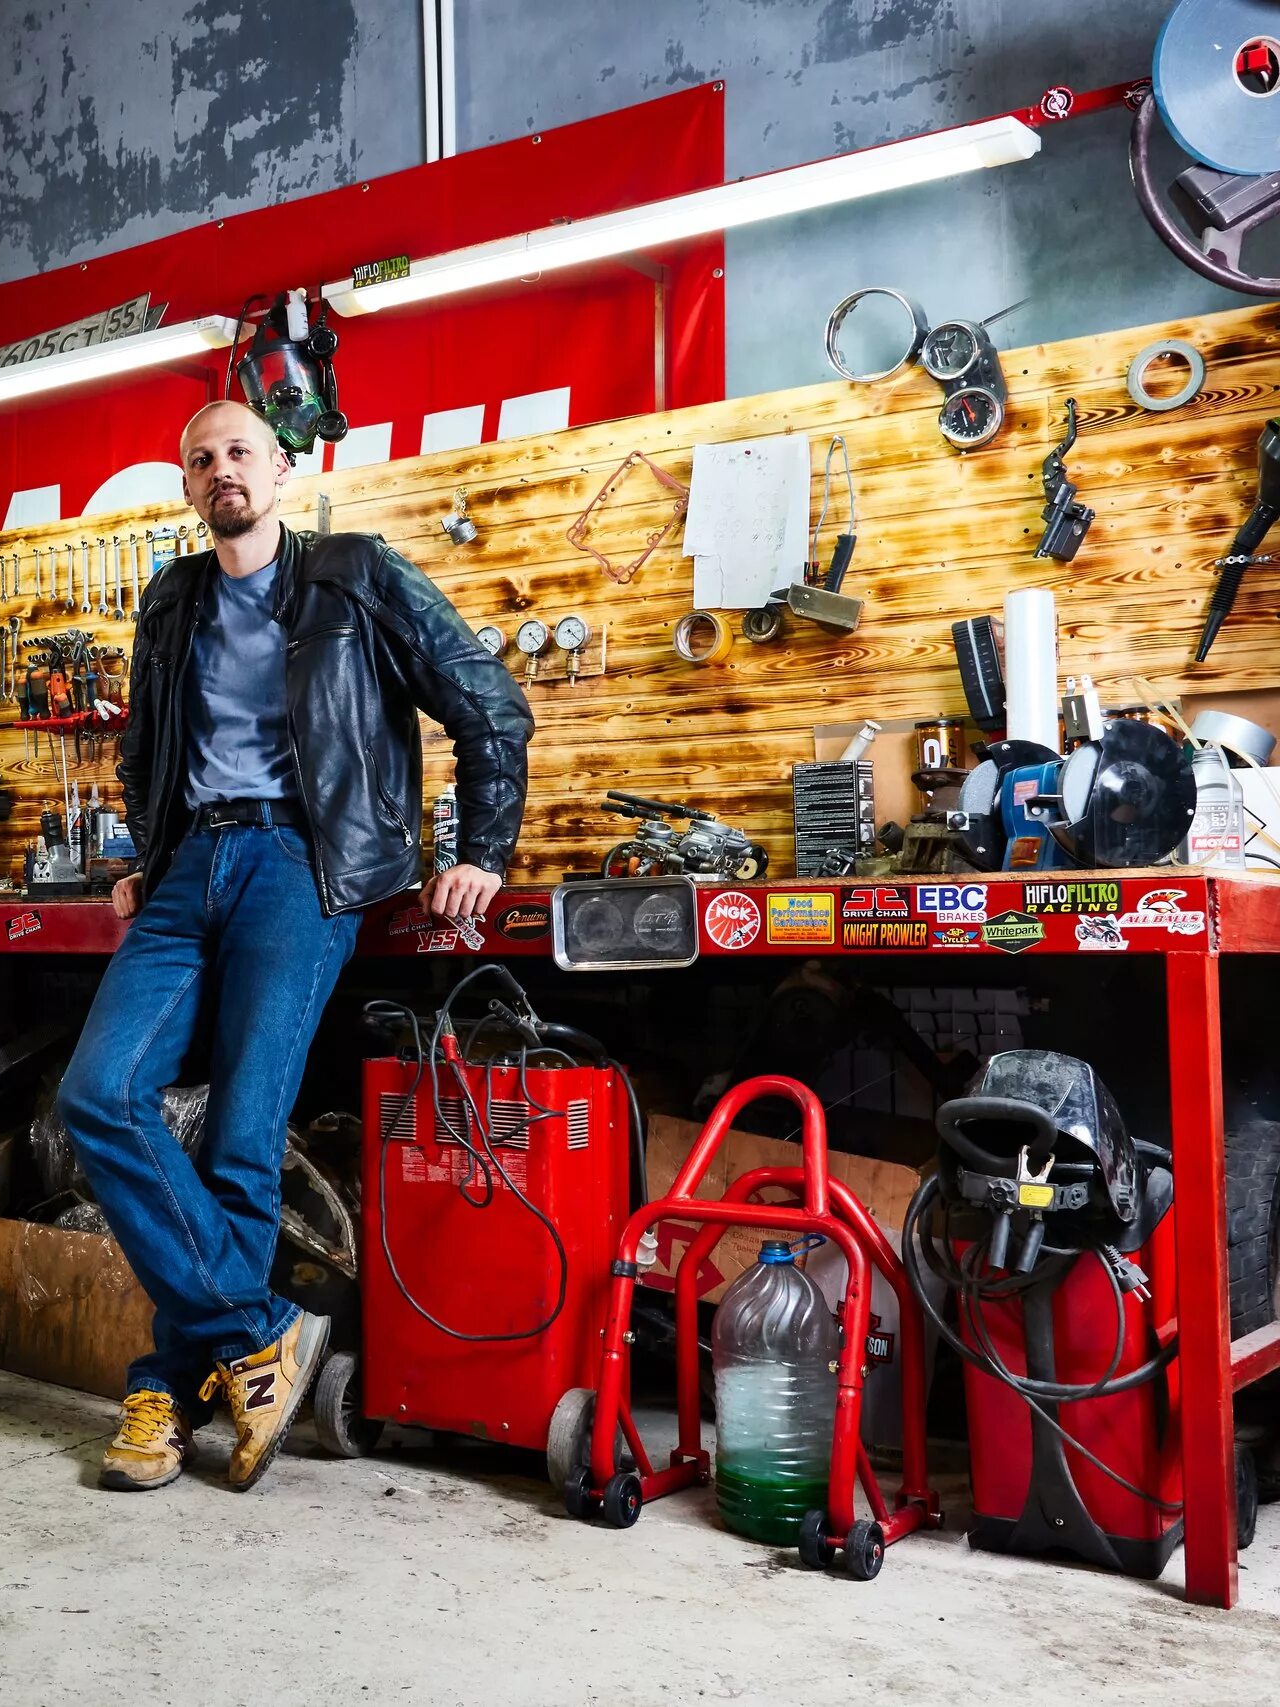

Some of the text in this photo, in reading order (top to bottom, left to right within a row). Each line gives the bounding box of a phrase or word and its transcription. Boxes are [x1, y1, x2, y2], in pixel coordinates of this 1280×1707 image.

[354, 256, 408, 280] HIFLOFILTRO
[355, 270, 408, 287] RACING
[108, 301, 137, 333] 55
[919, 886, 984, 911] EBC
[1026, 883, 1118, 904] HIFLOFILTRO
[715, 905, 751, 921] NGK
[771, 908, 829, 918] Performance
[843, 910, 874, 918] DRIVE
[1027, 903, 1118, 913] RACING
[504, 910, 548, 925] Genuine
[773, 917, 828, 927] Carburetors
[939, 912, 985, 921] BRAKES
[1125, 914, 1200, 923] ALL BALLS
[389, 923, 433, 936] DRIVE CHAIN
[843, 923, 927, 946] KNIGHT PROWLER
[985, 924, 1039, 938] Whitepark
[418, 930, 458, 952] YSS
[942, 935, 970, 943] CYCLES
[244, 1372, 276, 1412] N
